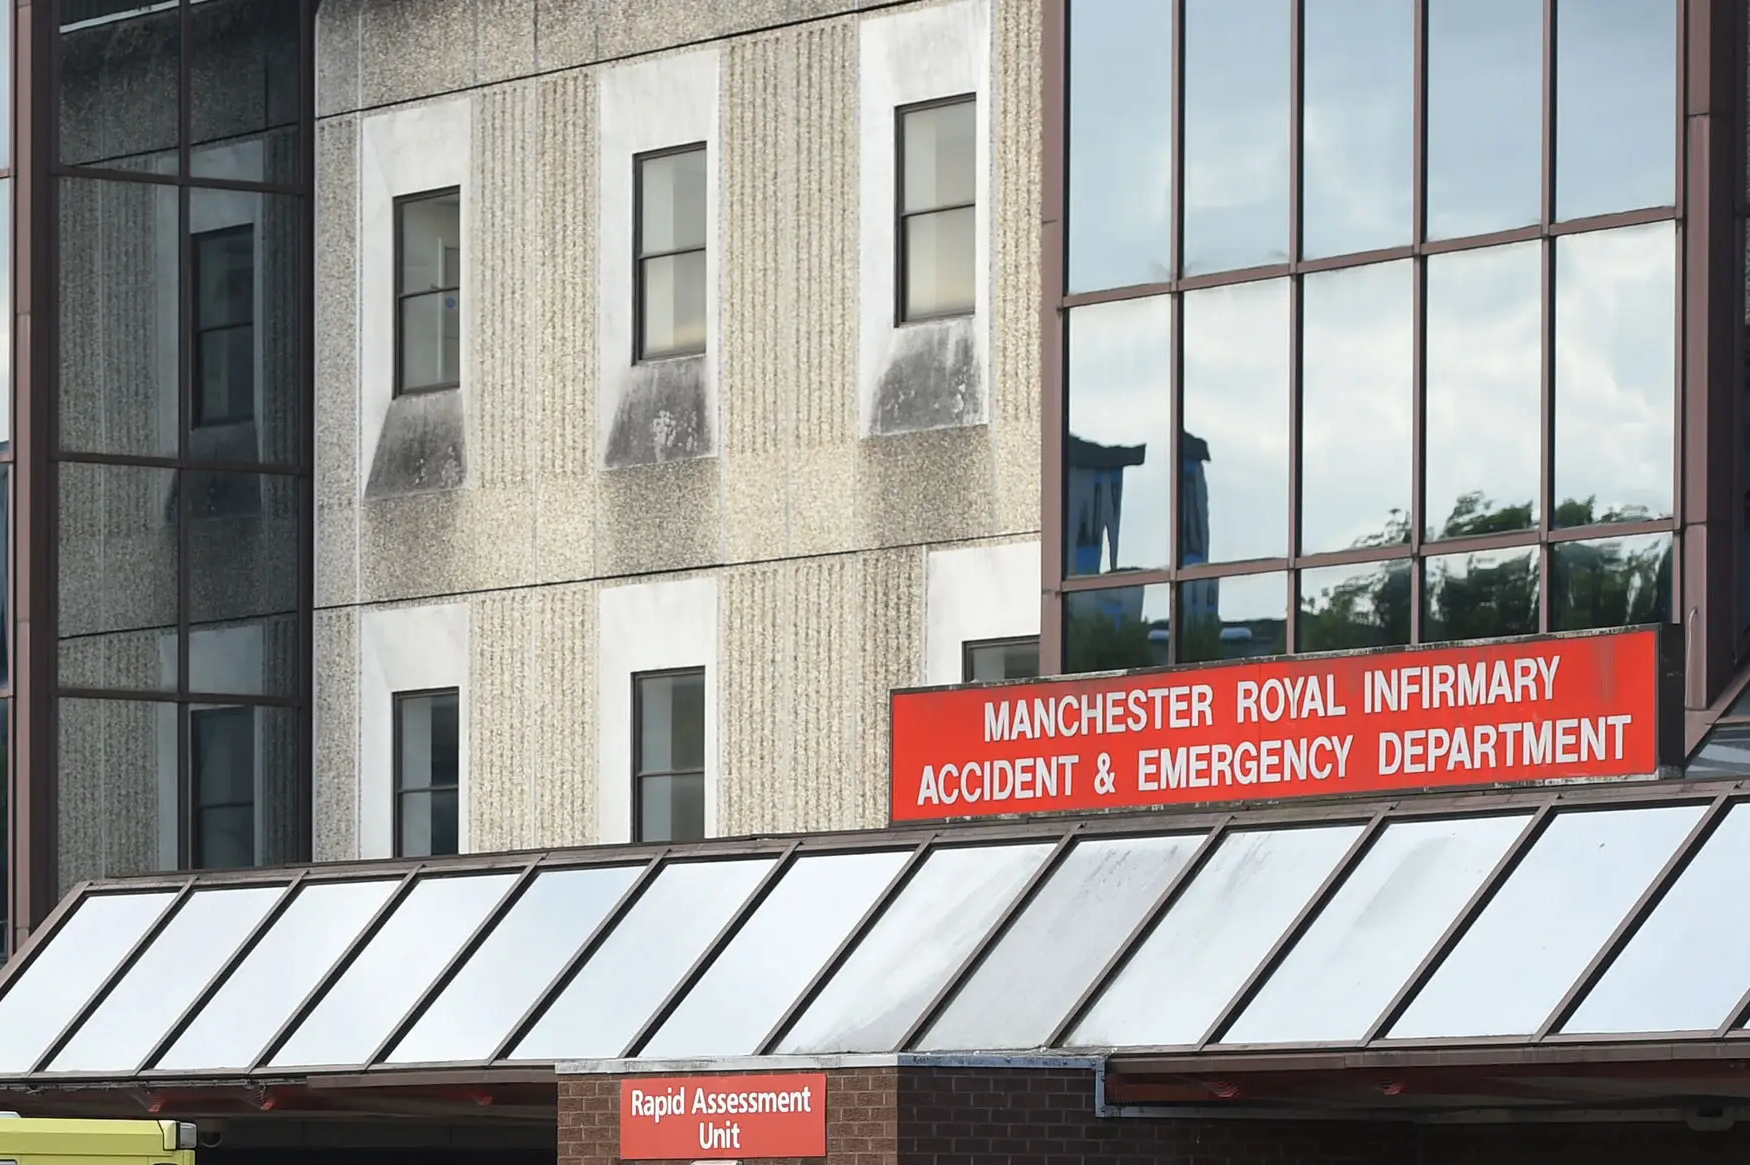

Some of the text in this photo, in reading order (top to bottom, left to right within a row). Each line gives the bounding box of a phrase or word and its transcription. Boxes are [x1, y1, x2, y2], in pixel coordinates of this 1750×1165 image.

[983, 655, 1561, 743] MANCHESTER ROYAL INFIRMARY
[917, 714, 1632, 806] ACCIDENT & EMERGENCY DEPARTMENT
[631, 1086, 811, 1123] Rapid Assessment
[699, 1120, 741, 1149] Unit
